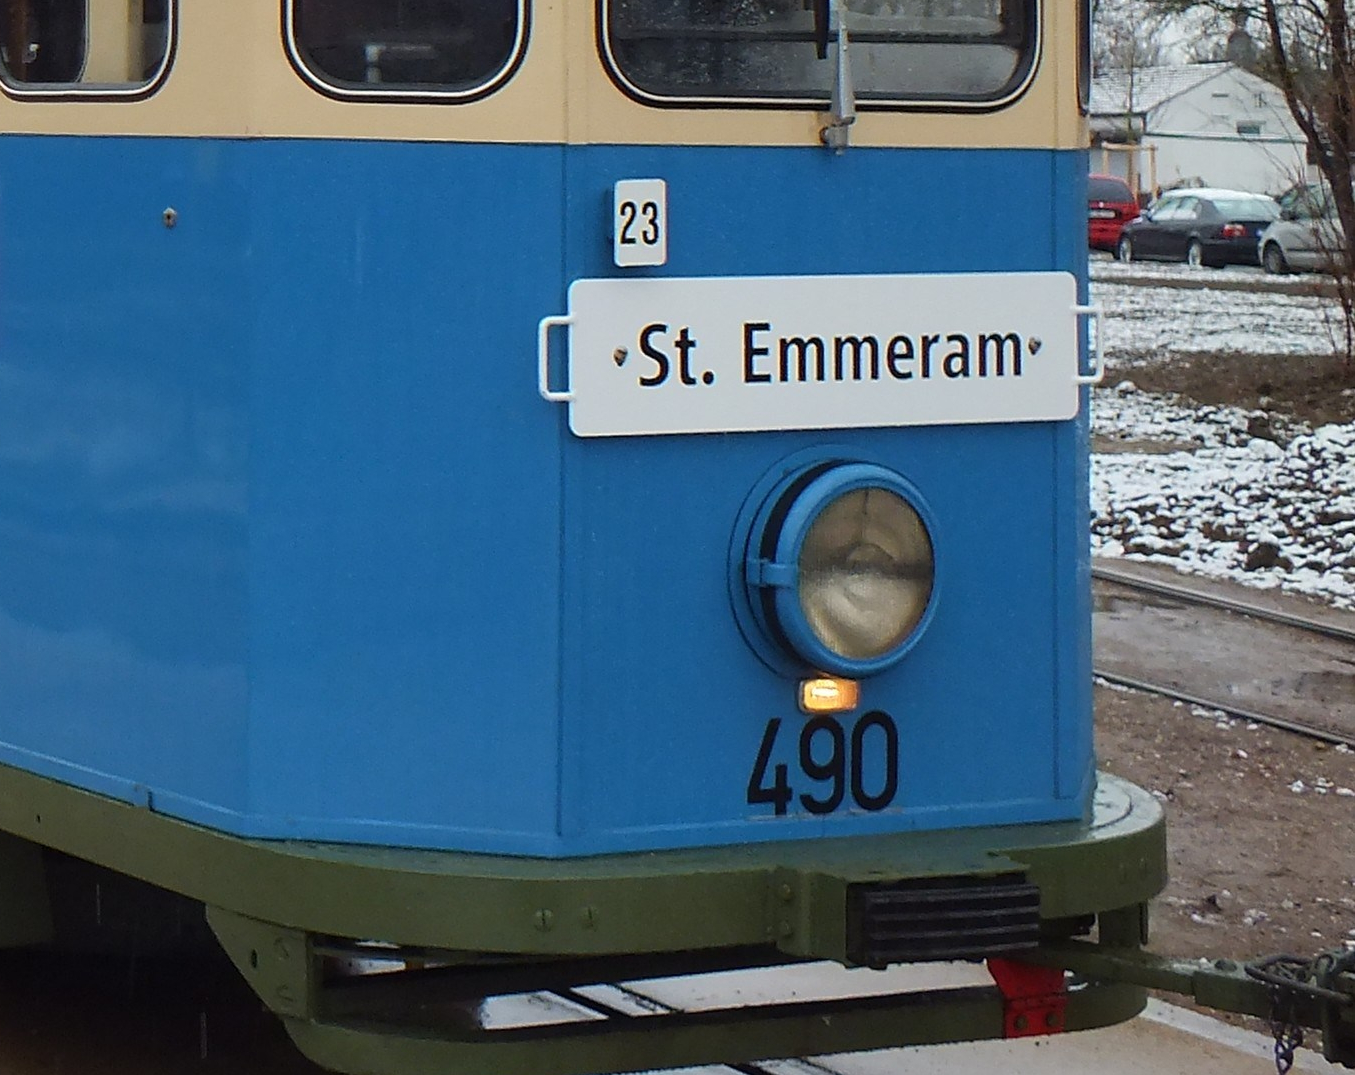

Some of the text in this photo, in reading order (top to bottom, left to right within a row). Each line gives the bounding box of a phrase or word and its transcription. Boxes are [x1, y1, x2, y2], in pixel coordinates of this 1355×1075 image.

[619, 201, 660, 246] 23
[638, 322, 1023, 387] St. Emmeram
[747, 710, 899, 816] 490
